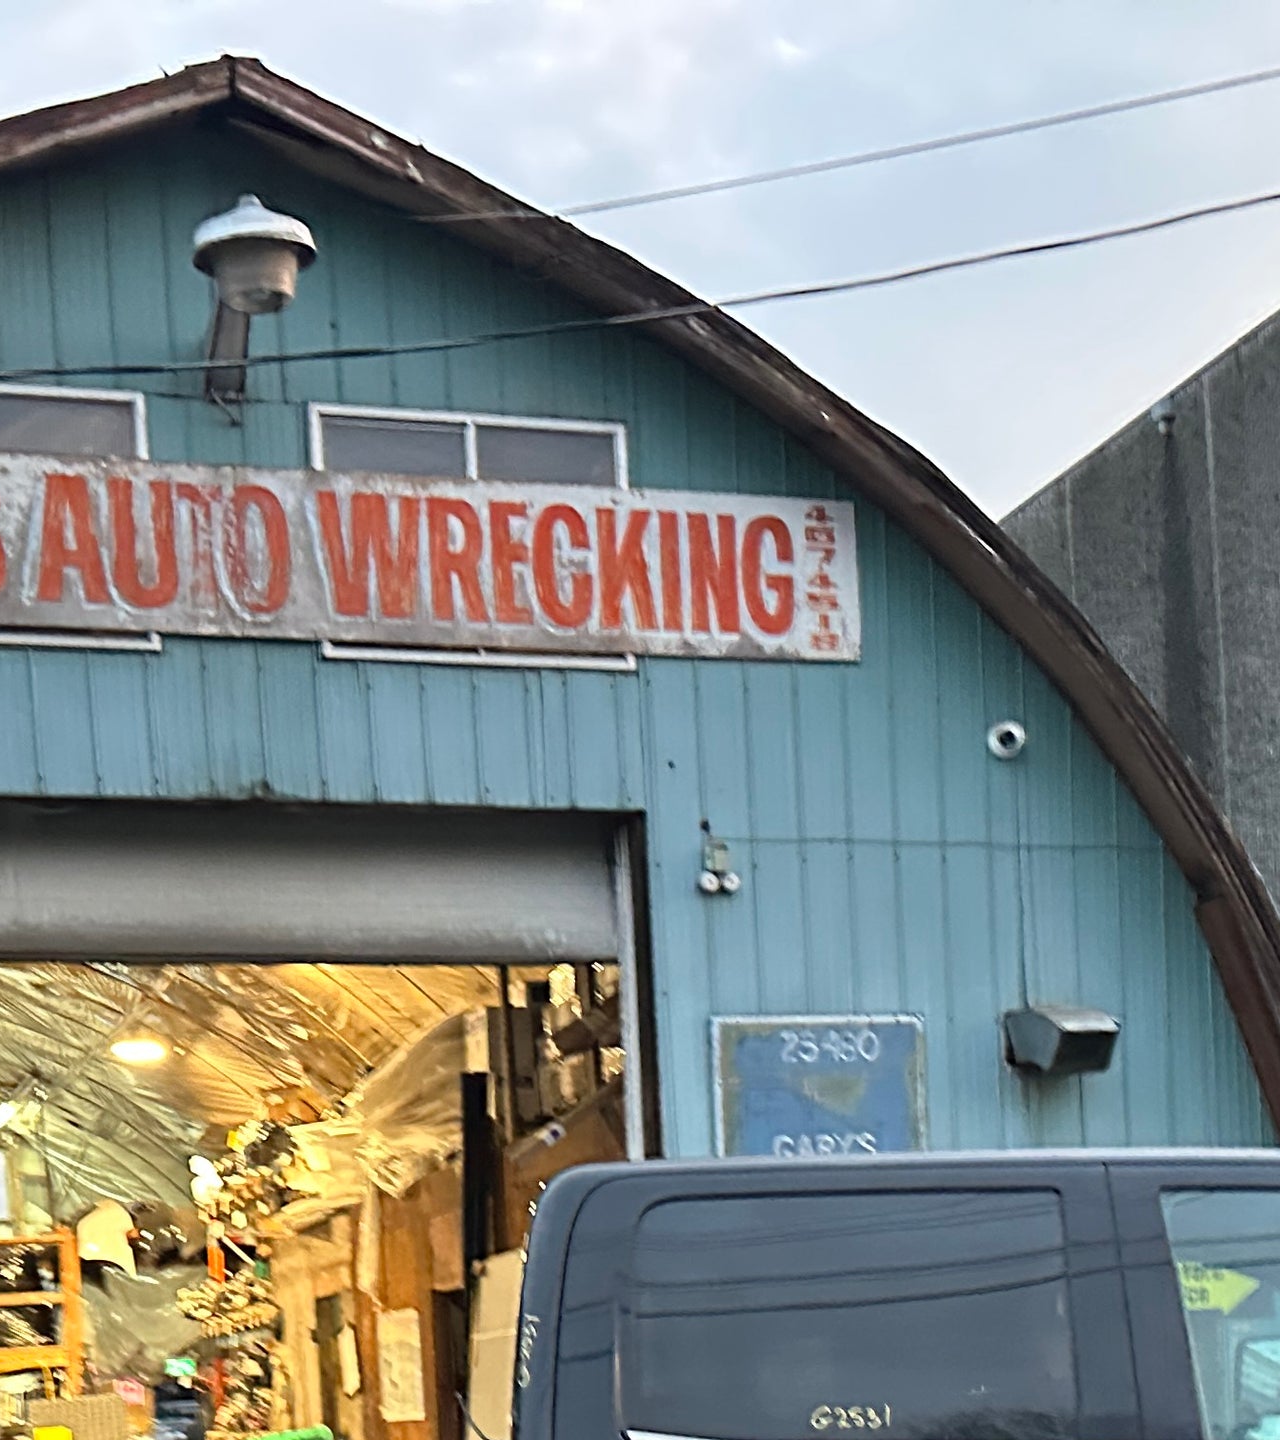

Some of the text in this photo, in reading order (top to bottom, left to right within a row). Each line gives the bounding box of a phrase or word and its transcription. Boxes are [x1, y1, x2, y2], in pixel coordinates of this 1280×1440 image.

[36, 472, 291, 615] AUTO
[315, 488, 794, 636] WRECKING
[809, 1402, 892, 1430] G2531
